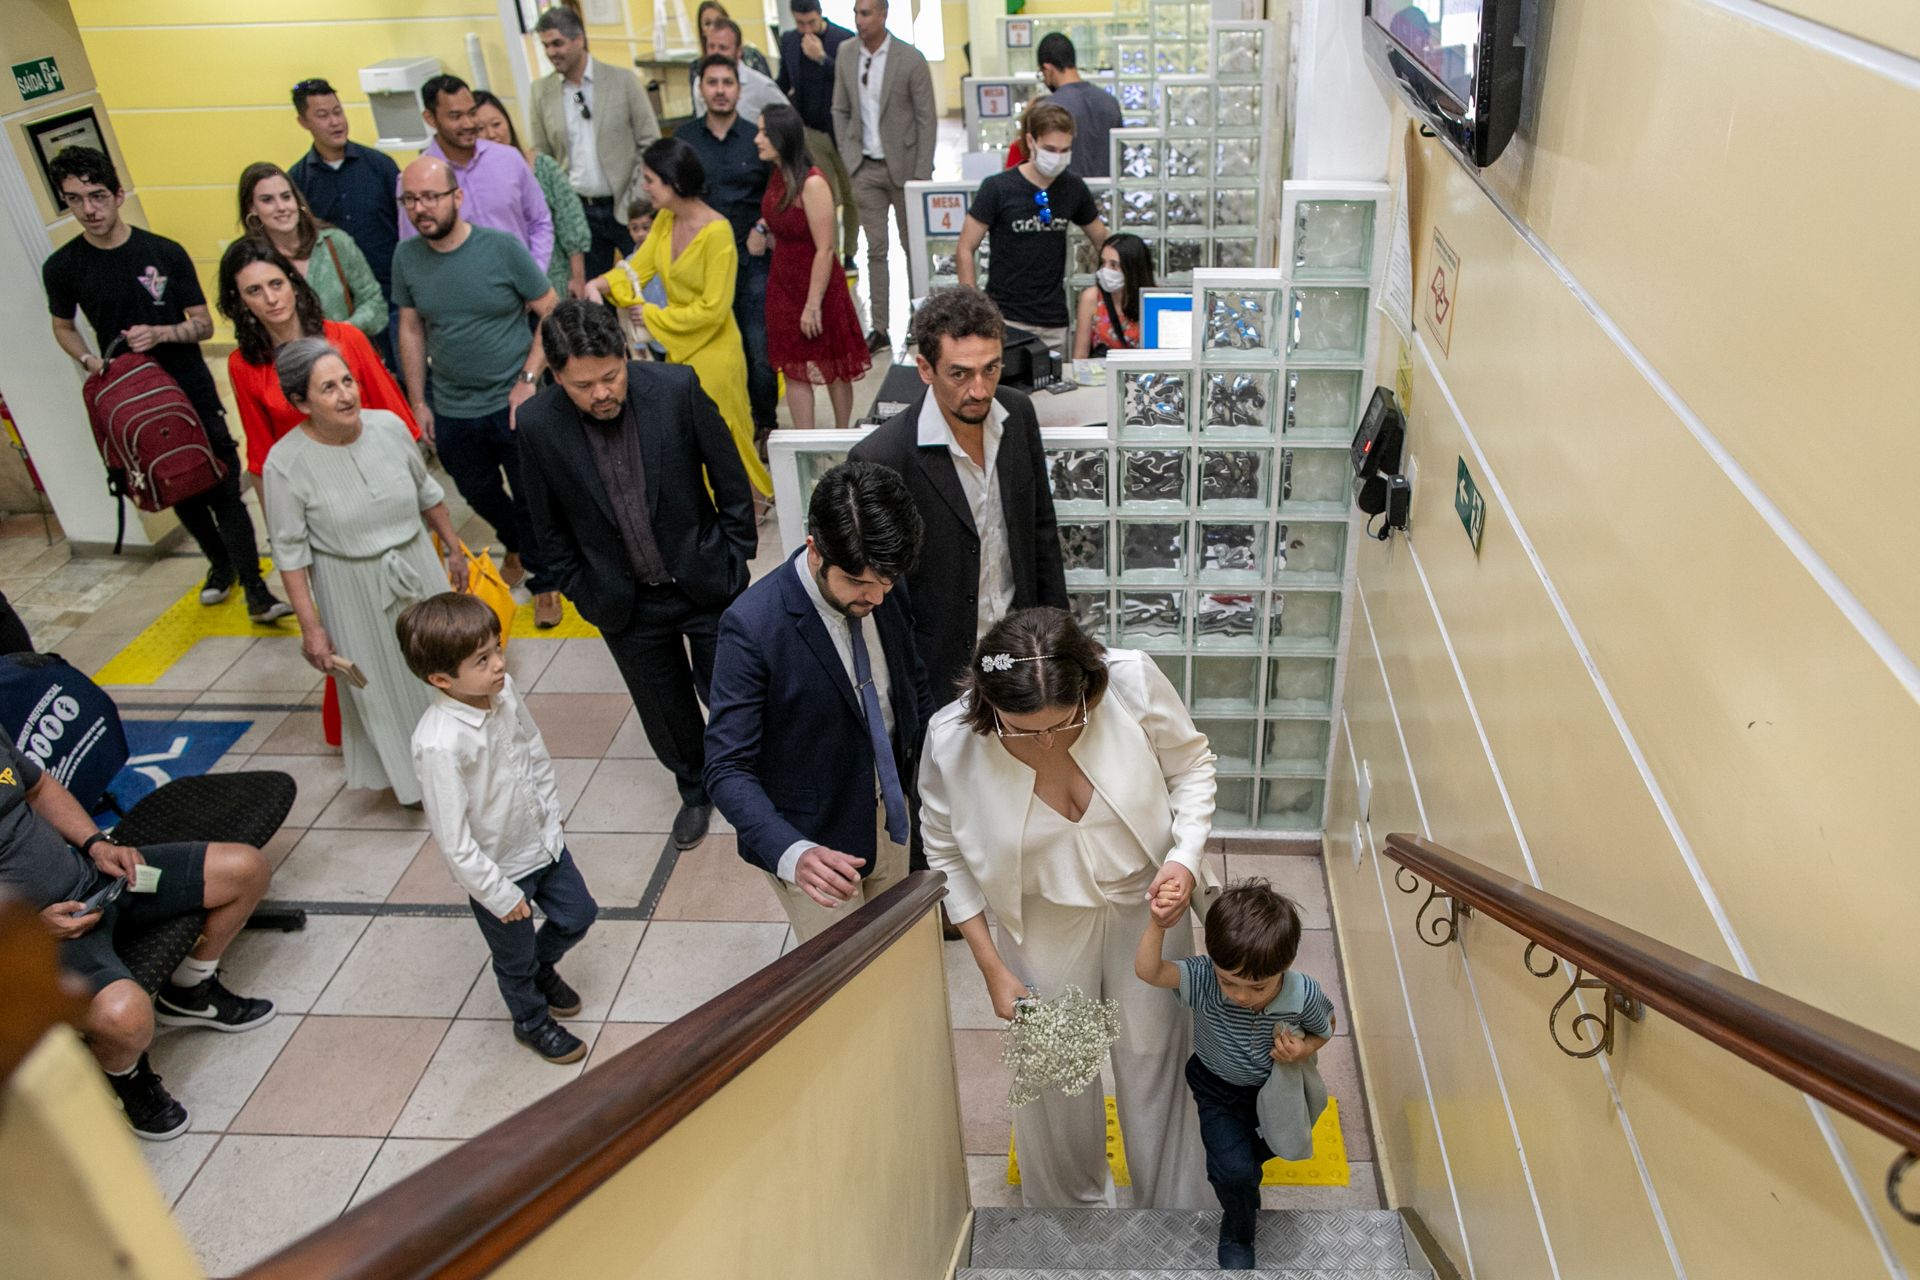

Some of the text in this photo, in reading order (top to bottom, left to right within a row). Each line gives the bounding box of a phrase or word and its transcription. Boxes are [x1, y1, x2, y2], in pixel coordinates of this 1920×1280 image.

[16, 69, 46, 94] SAÍDA
[983, 88, 1004, 97] MESA
[990, 100, 998, 113] 3
[932, 196, 961, 208] MESA
[941, 211, 951, 230] 4
